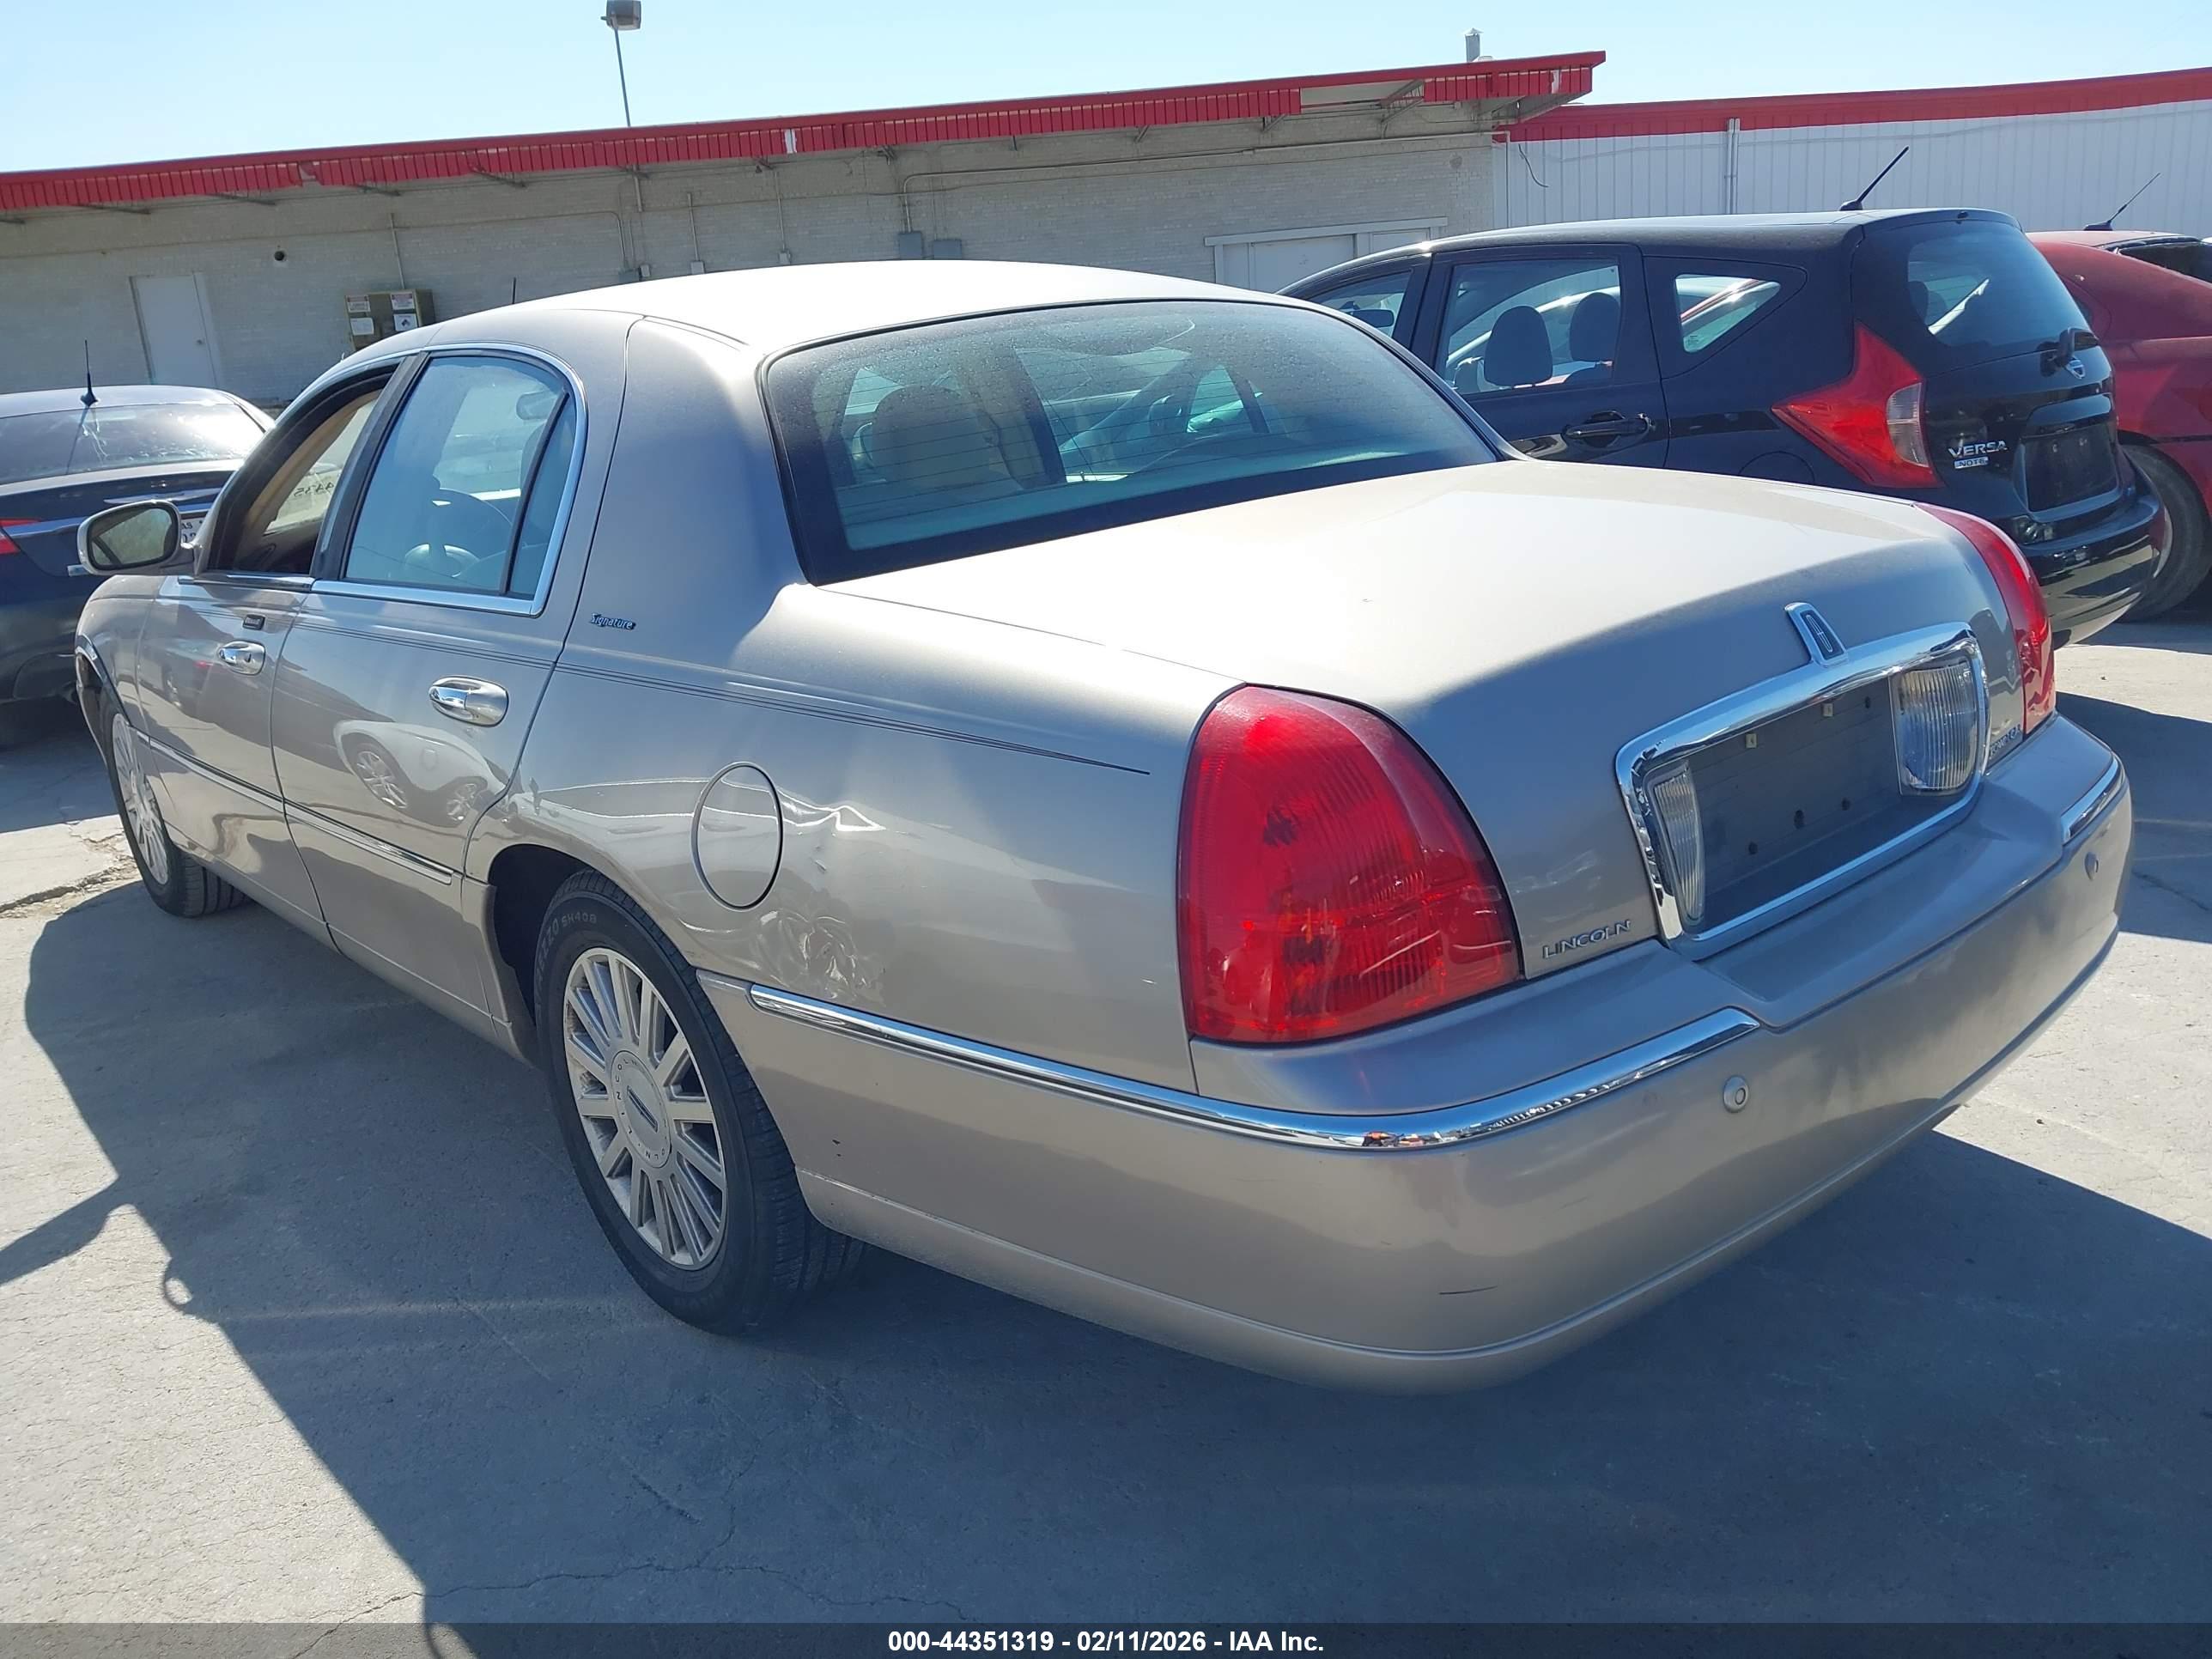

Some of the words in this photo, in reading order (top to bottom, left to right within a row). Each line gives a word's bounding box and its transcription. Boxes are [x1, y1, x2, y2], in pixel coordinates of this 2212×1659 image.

[1948, 440, 2008, 458] VERSA
[1957, 458, 1988, 467] NOTE
[591, 612, 635, 629] Signature
[562, 912, 598, 928] SH408
[1542, 919, 1631, 959] LINCOLN
